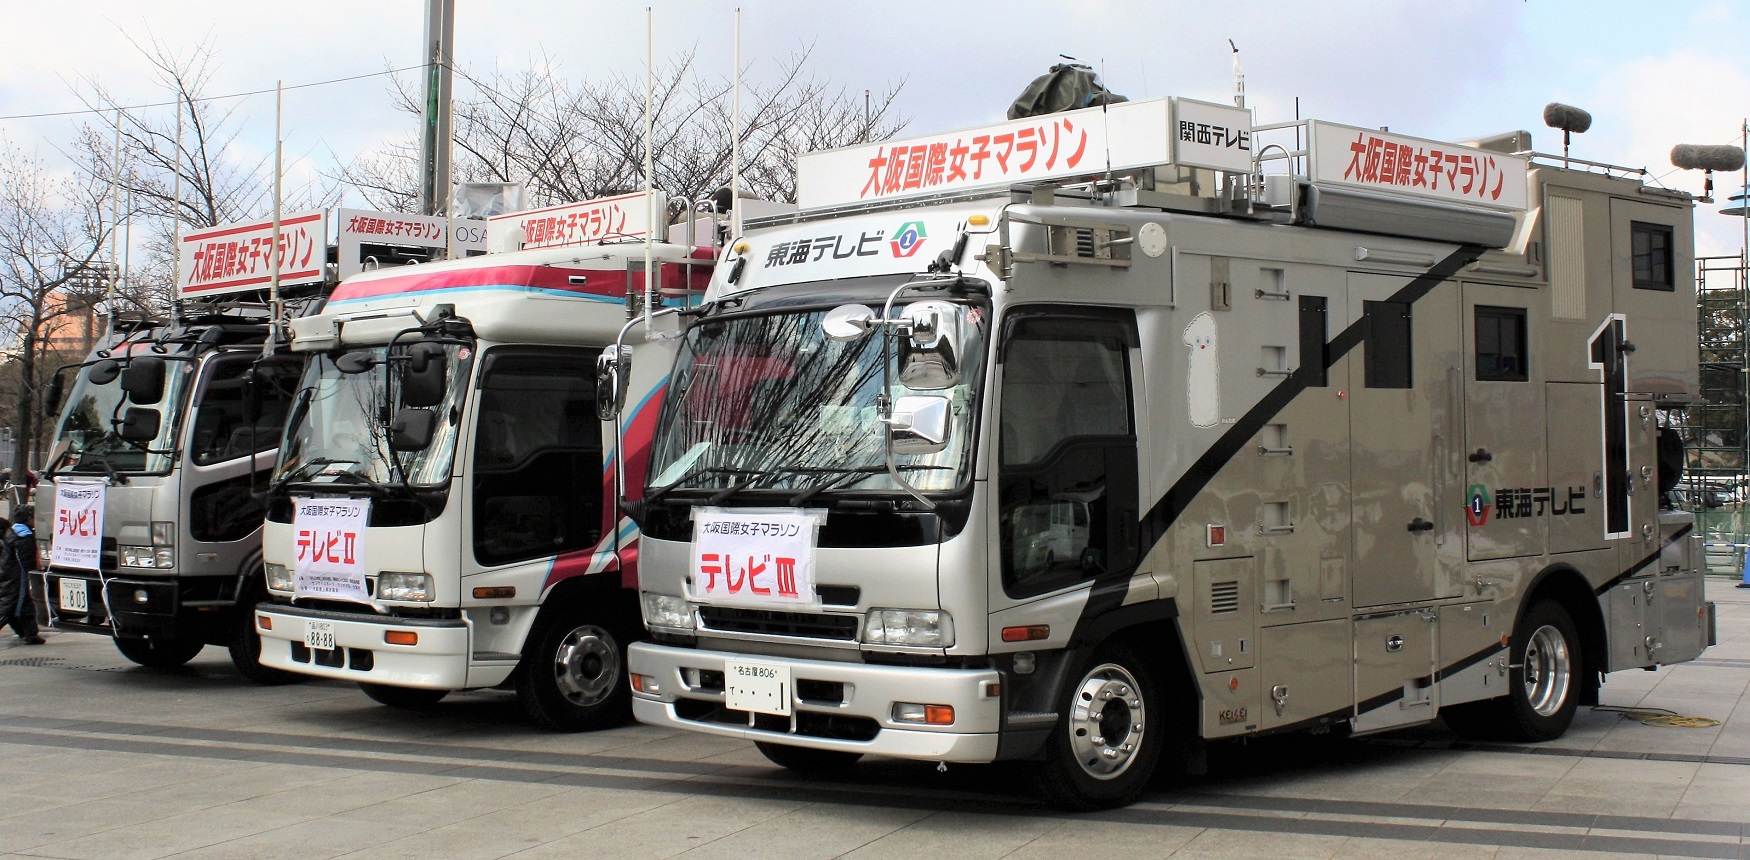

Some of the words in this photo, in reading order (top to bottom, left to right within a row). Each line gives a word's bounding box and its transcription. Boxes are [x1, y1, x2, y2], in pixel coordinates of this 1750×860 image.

[1180, 120, 1249, 150] 関西テレビ
[861, 117, 1087, 199] 大阪国際女子マラソン
[1344, 132, 1504, 200] 大阪国際女子マラソン
[346, 215, 441, 240] 大阪国際女子マラソン
[188, 226, 313, 284] 大阪国際女子マラソン
[765, 230, 885, 269] 東海テレビ
[60, 489, 100, 499] 子マラソン
[1495, 486, 1586, 519] 東海テレビ
[300, 506, 361, 518] 大阪国際女子マラソン
[703, 521, 800, 537] 大阪国際女子マラソン
[738, 666, 775, 678] 名古屋806
